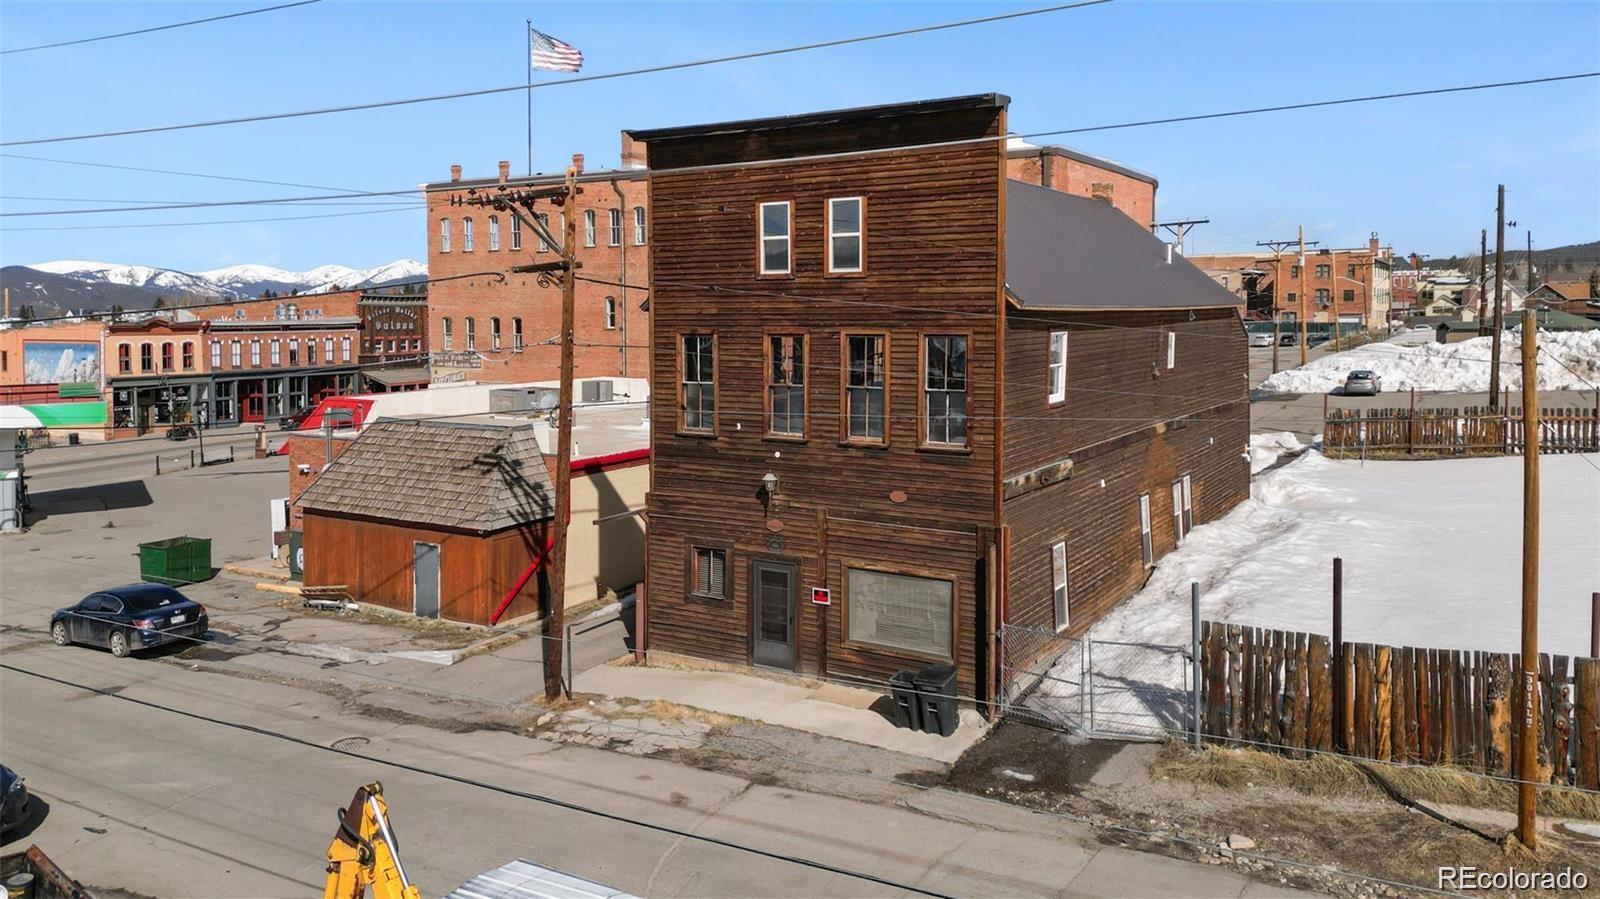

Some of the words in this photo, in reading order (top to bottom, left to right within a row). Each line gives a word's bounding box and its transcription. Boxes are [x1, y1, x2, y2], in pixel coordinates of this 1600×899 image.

[367, 307, 390, 321] Silver
[395, 306, 418, 320] Dollar
[375, 320, 414, 330] Saloon
